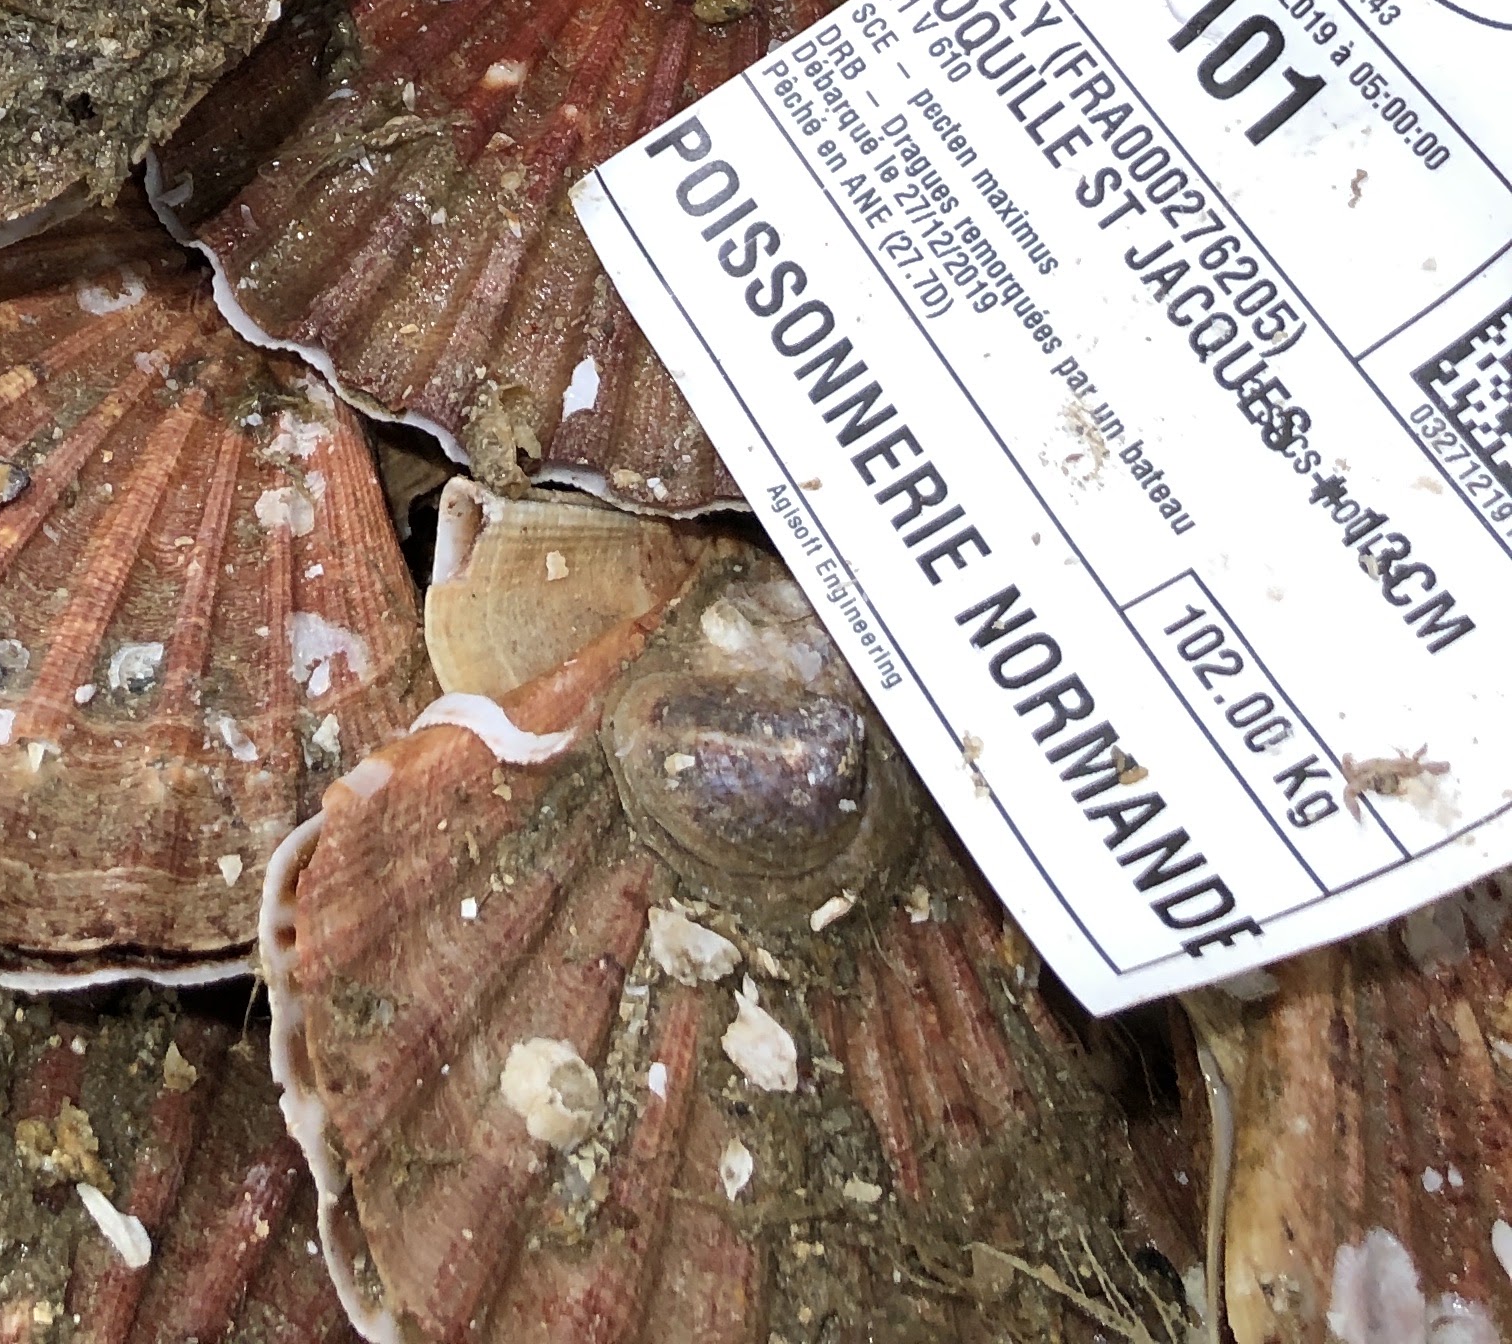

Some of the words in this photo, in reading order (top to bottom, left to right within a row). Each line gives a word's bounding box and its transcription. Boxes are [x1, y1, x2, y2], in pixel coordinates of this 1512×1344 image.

[793, 41, 884, 154] Débarqué
[875, 155, 898, 182] le
[894, 185, 997, 312] 27/12/2019
[853, 4, 898, 53] SCE
[908, 89, 976, 167] pecten
[973, 169, 1058, 274] maximus
[914, 12, 938, 33] V
[930, 37, 971, 82] 610
[1331, 42, 1353, 66] à
[1350, 63, 1450, 170] 05:00:00
[764, 61, 826, 135] Pêché
[818, 141, 846, 172] en
[841, 175, 892, 229] ANE
[879, 231, 953, 318] (27.7D)
[817, 24, 866, 79] DRB
[882, 115, 958, 213] Dragues
[949, 217, 1061, 353] remorquées
[1051, 357, 1096, 396] par
[1093, 400, 1125, 438] un
[1119, 440, 1195, 534] bateau
[1039, 43, 1306, 357] (FRA000276205)
[1077, 168, 1146, 229] ST
[1125, 241, 1311, 453] JACQUES
[645, 117, 991, 585] POISSONNERIE
[956, 585, 1263, 958] NORMANDE
[767, 485, 822, 555] Agisoft
[817, 559, 902, 689] Engineering
[1409, 402, 1512, 538] 03271219
[1165, 606, 1291, 752] 102.00
[1275, 755, 1338, 827] Kg
